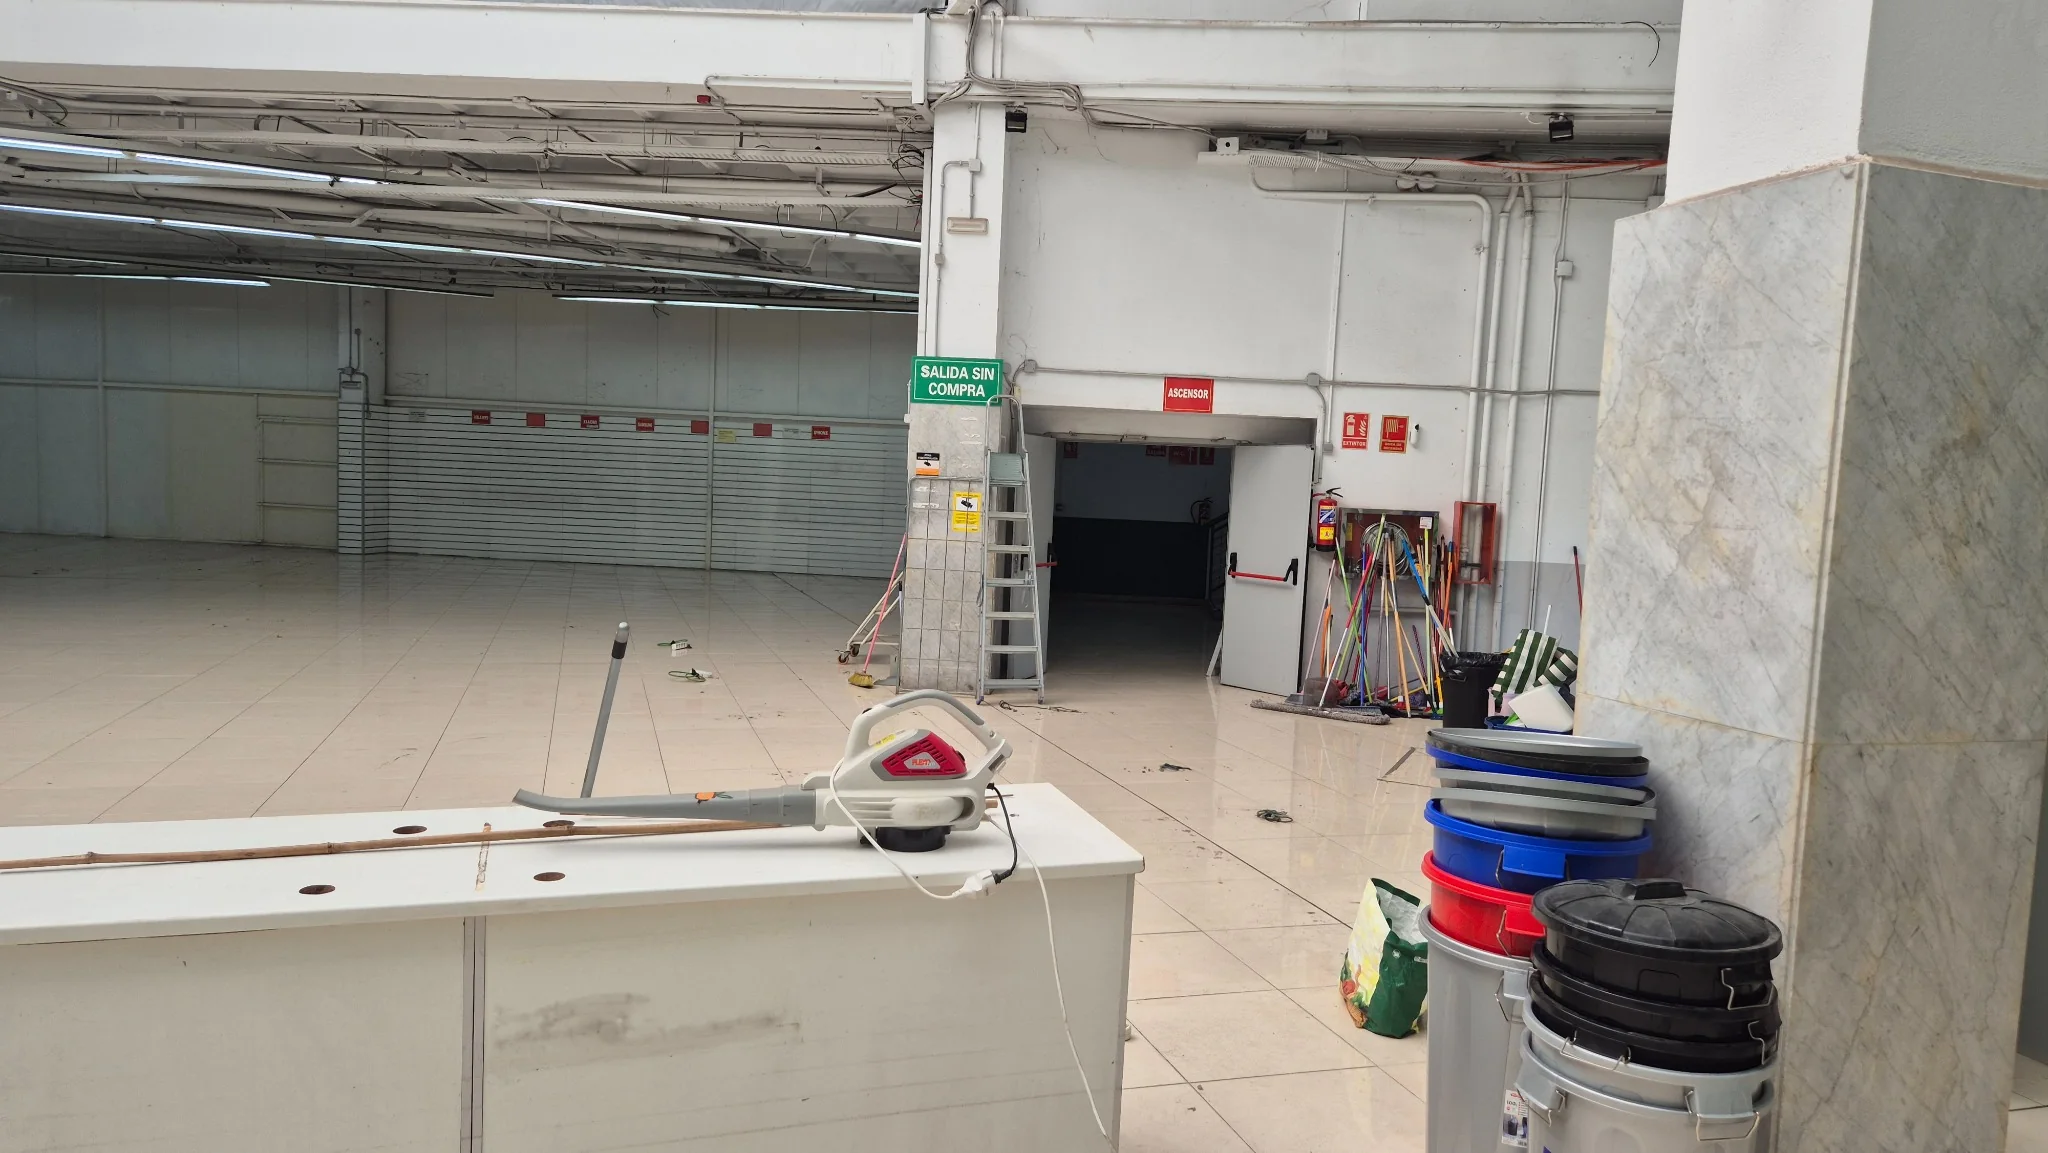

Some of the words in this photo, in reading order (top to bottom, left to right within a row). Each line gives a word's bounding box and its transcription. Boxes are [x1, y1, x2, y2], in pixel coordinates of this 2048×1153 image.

[921, 365, 969, 380] SALIDA
[972, 367, 995, 380] SIN
[928, 382, 986, 397] COMPRA
[1168, 387, 1209, 399] ASCENSOR
